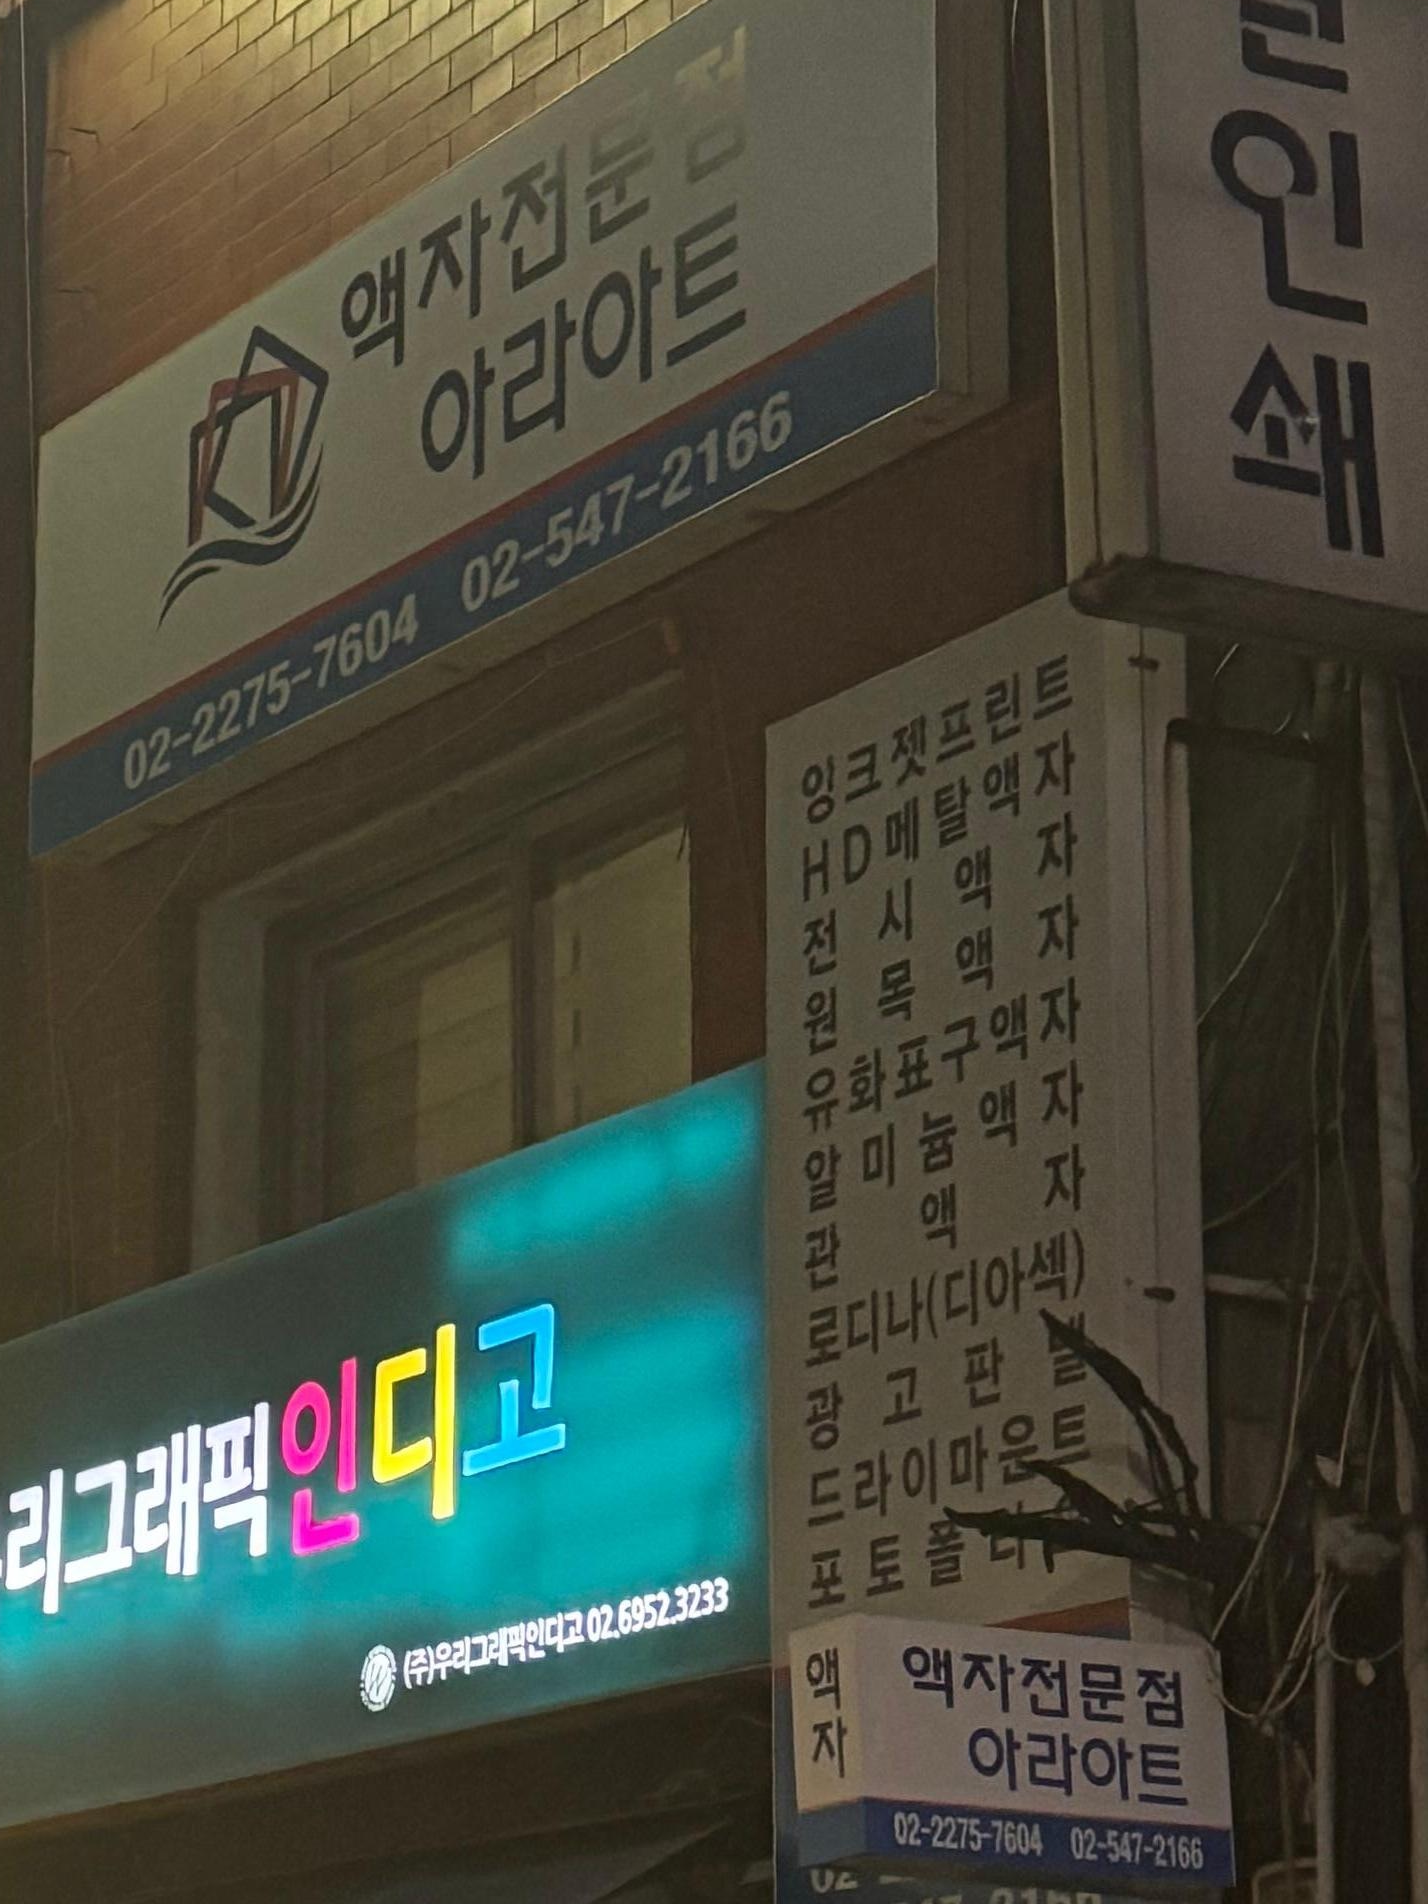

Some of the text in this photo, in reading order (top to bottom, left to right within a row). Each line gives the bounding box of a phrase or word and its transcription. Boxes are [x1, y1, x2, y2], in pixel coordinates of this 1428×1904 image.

[421, 204, 748, 479] 아라아트
[121, 390, 795, 790] 02-2275-7604 02-547-2166
[587, 1577, 729, 1643] 02.6952.3233
[902, 1645, 1185, 1729] 액자전문점
[967, 1727, 1188, 1806] 아라아트
[893, 1811, 1205, 1870] 02-2275-7604 02-547-2166
